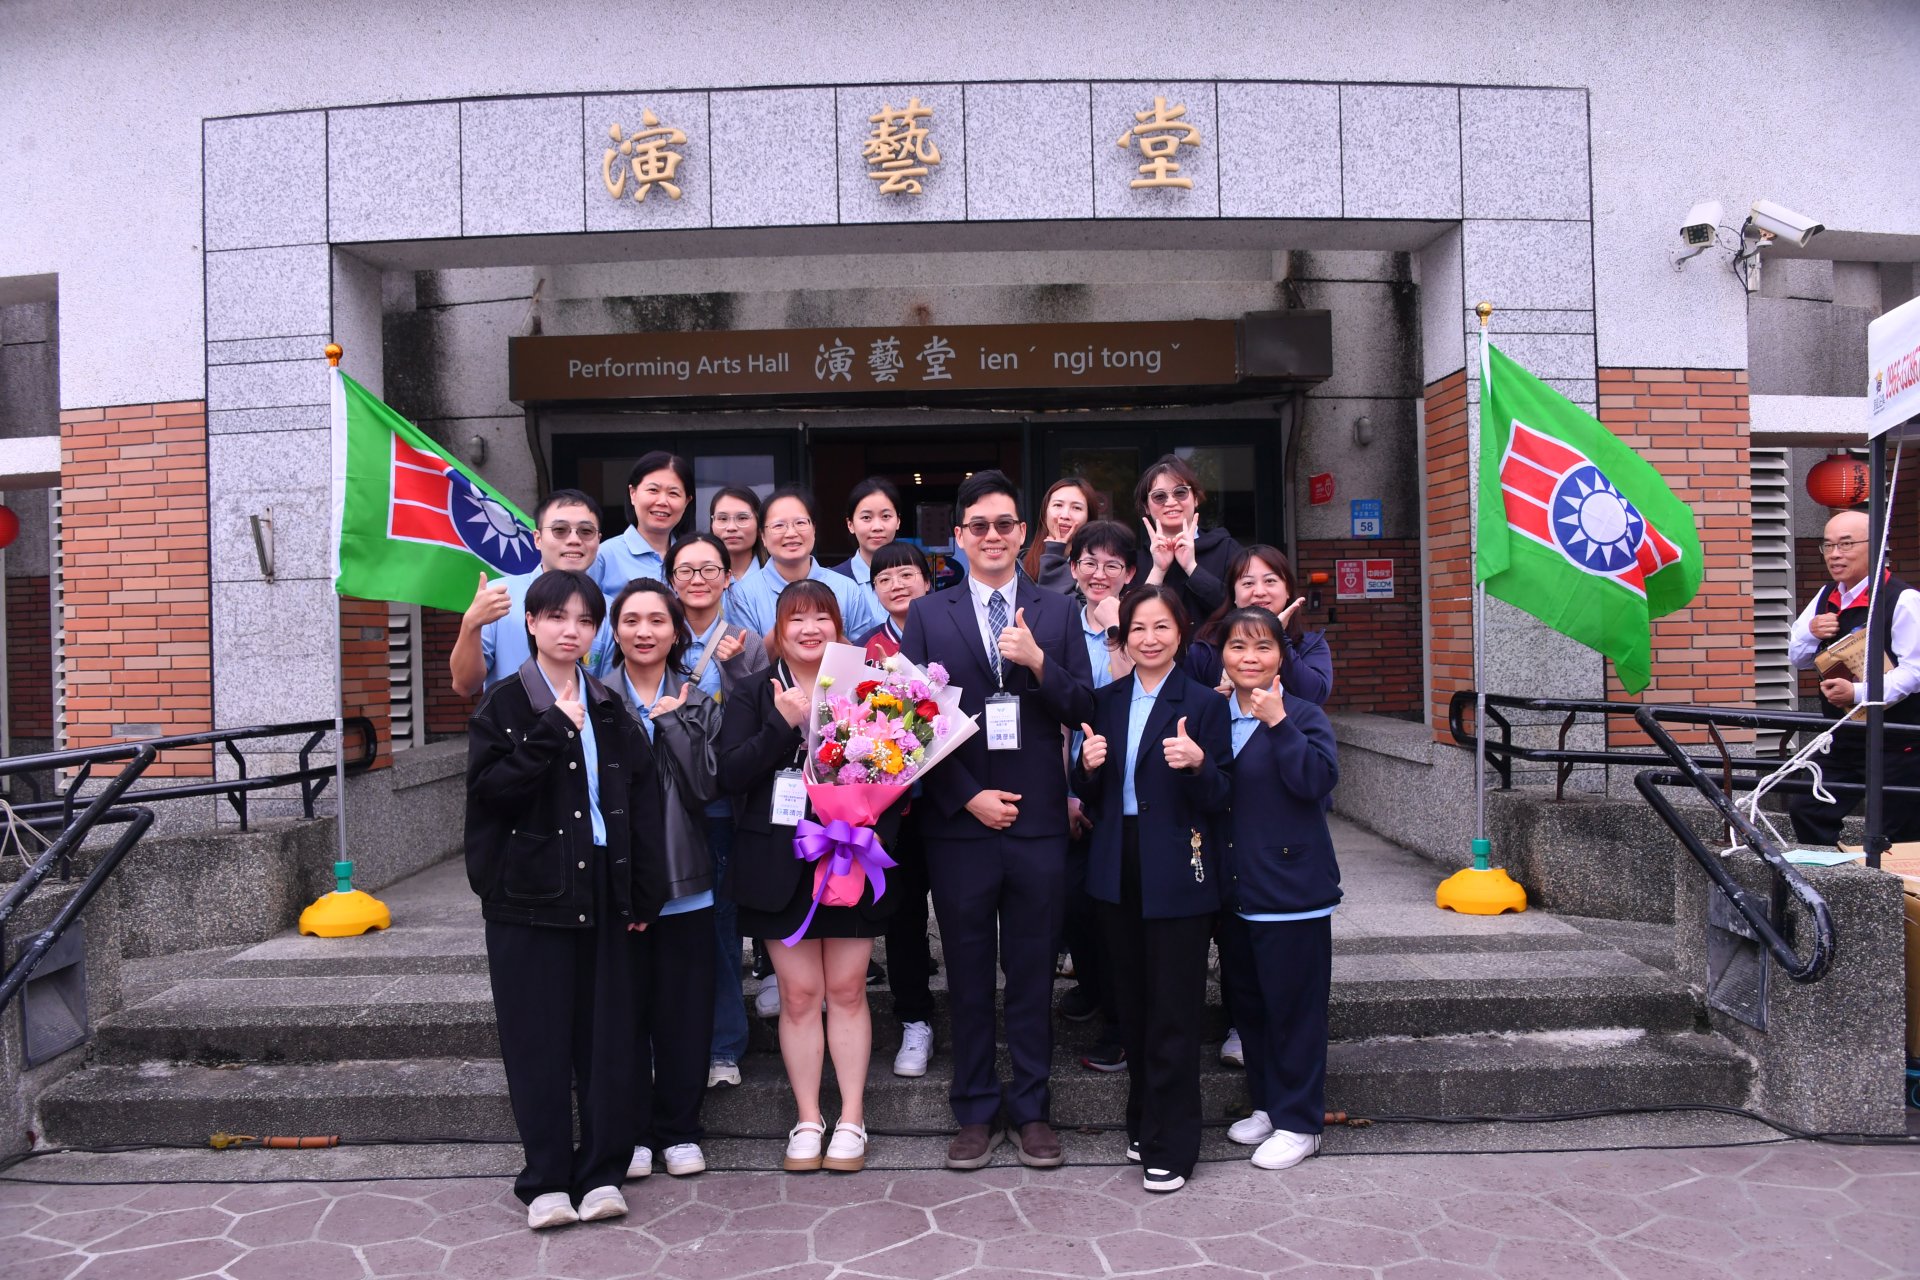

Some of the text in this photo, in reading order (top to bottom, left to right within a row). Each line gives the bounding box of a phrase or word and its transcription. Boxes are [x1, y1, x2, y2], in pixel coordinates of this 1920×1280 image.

[603, 97, 1200, 201] 演藝堂
[568, 357, 690, 380] Performing
[697, 355, 741, 375] Arts
[748, 352, 789, 374] Hall
[814, 335, 956, 383] 演藝堂
[1360, 521, 1373, 532] 58
